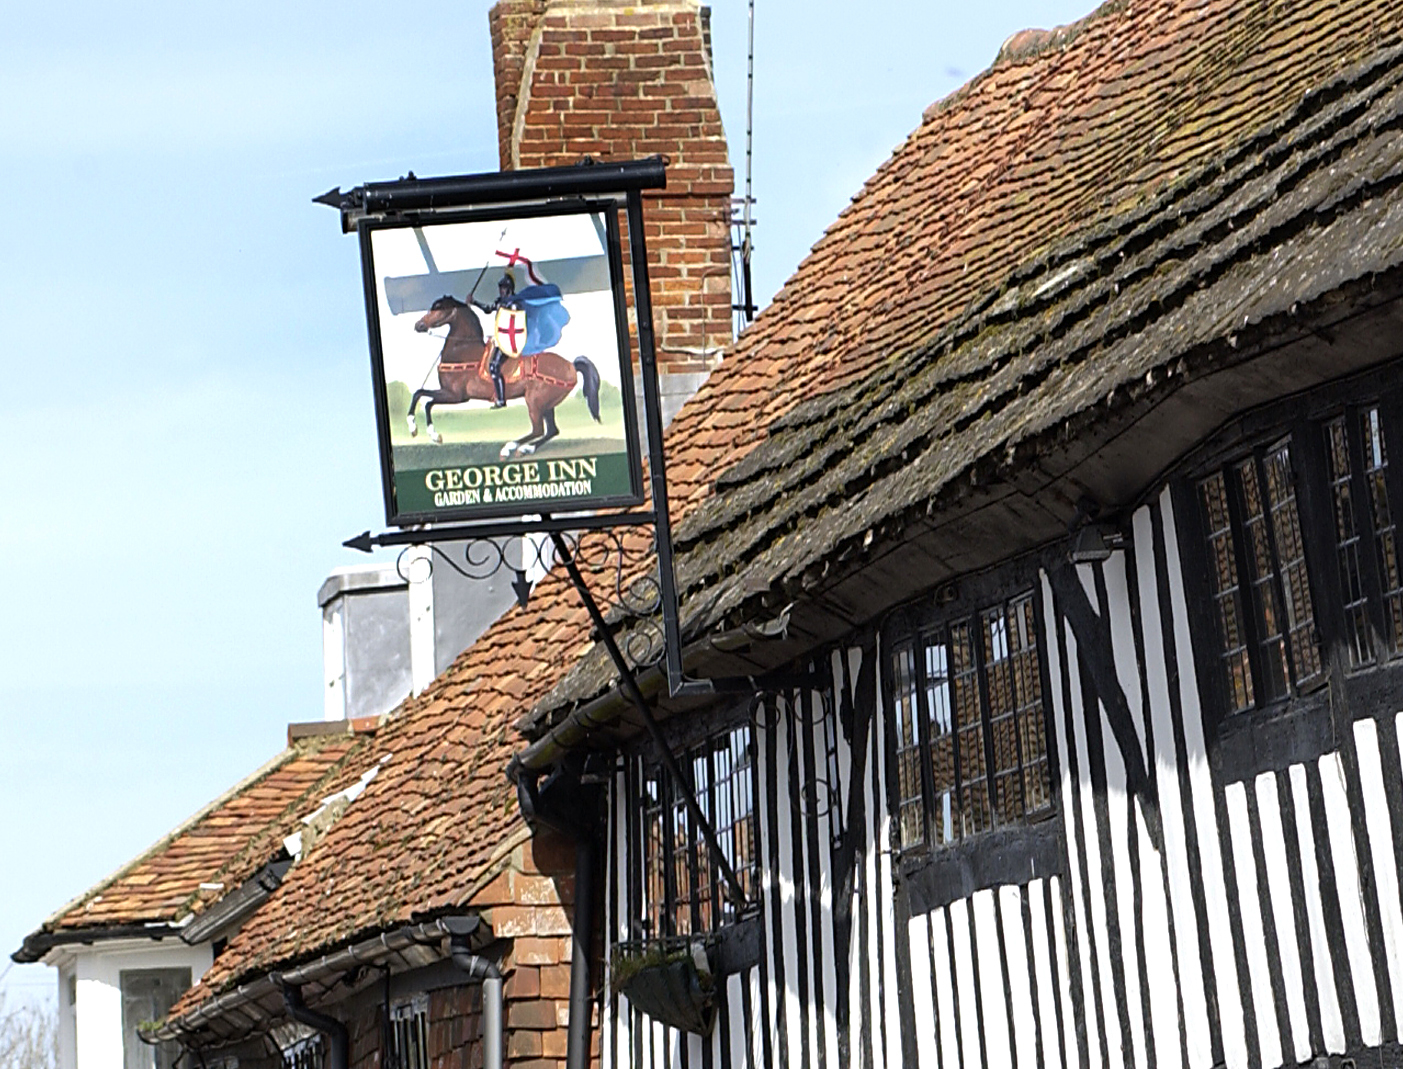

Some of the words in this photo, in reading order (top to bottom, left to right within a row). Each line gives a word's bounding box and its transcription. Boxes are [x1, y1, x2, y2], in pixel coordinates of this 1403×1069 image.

[425, 463, 540, 491] GEORGE
[548, 457, 598, 481] INN
[434, 488, 481, 508] GARDEN
[483, 487, 493, 503] &
[495, 479, 592, 503] ACCOMMODATION
